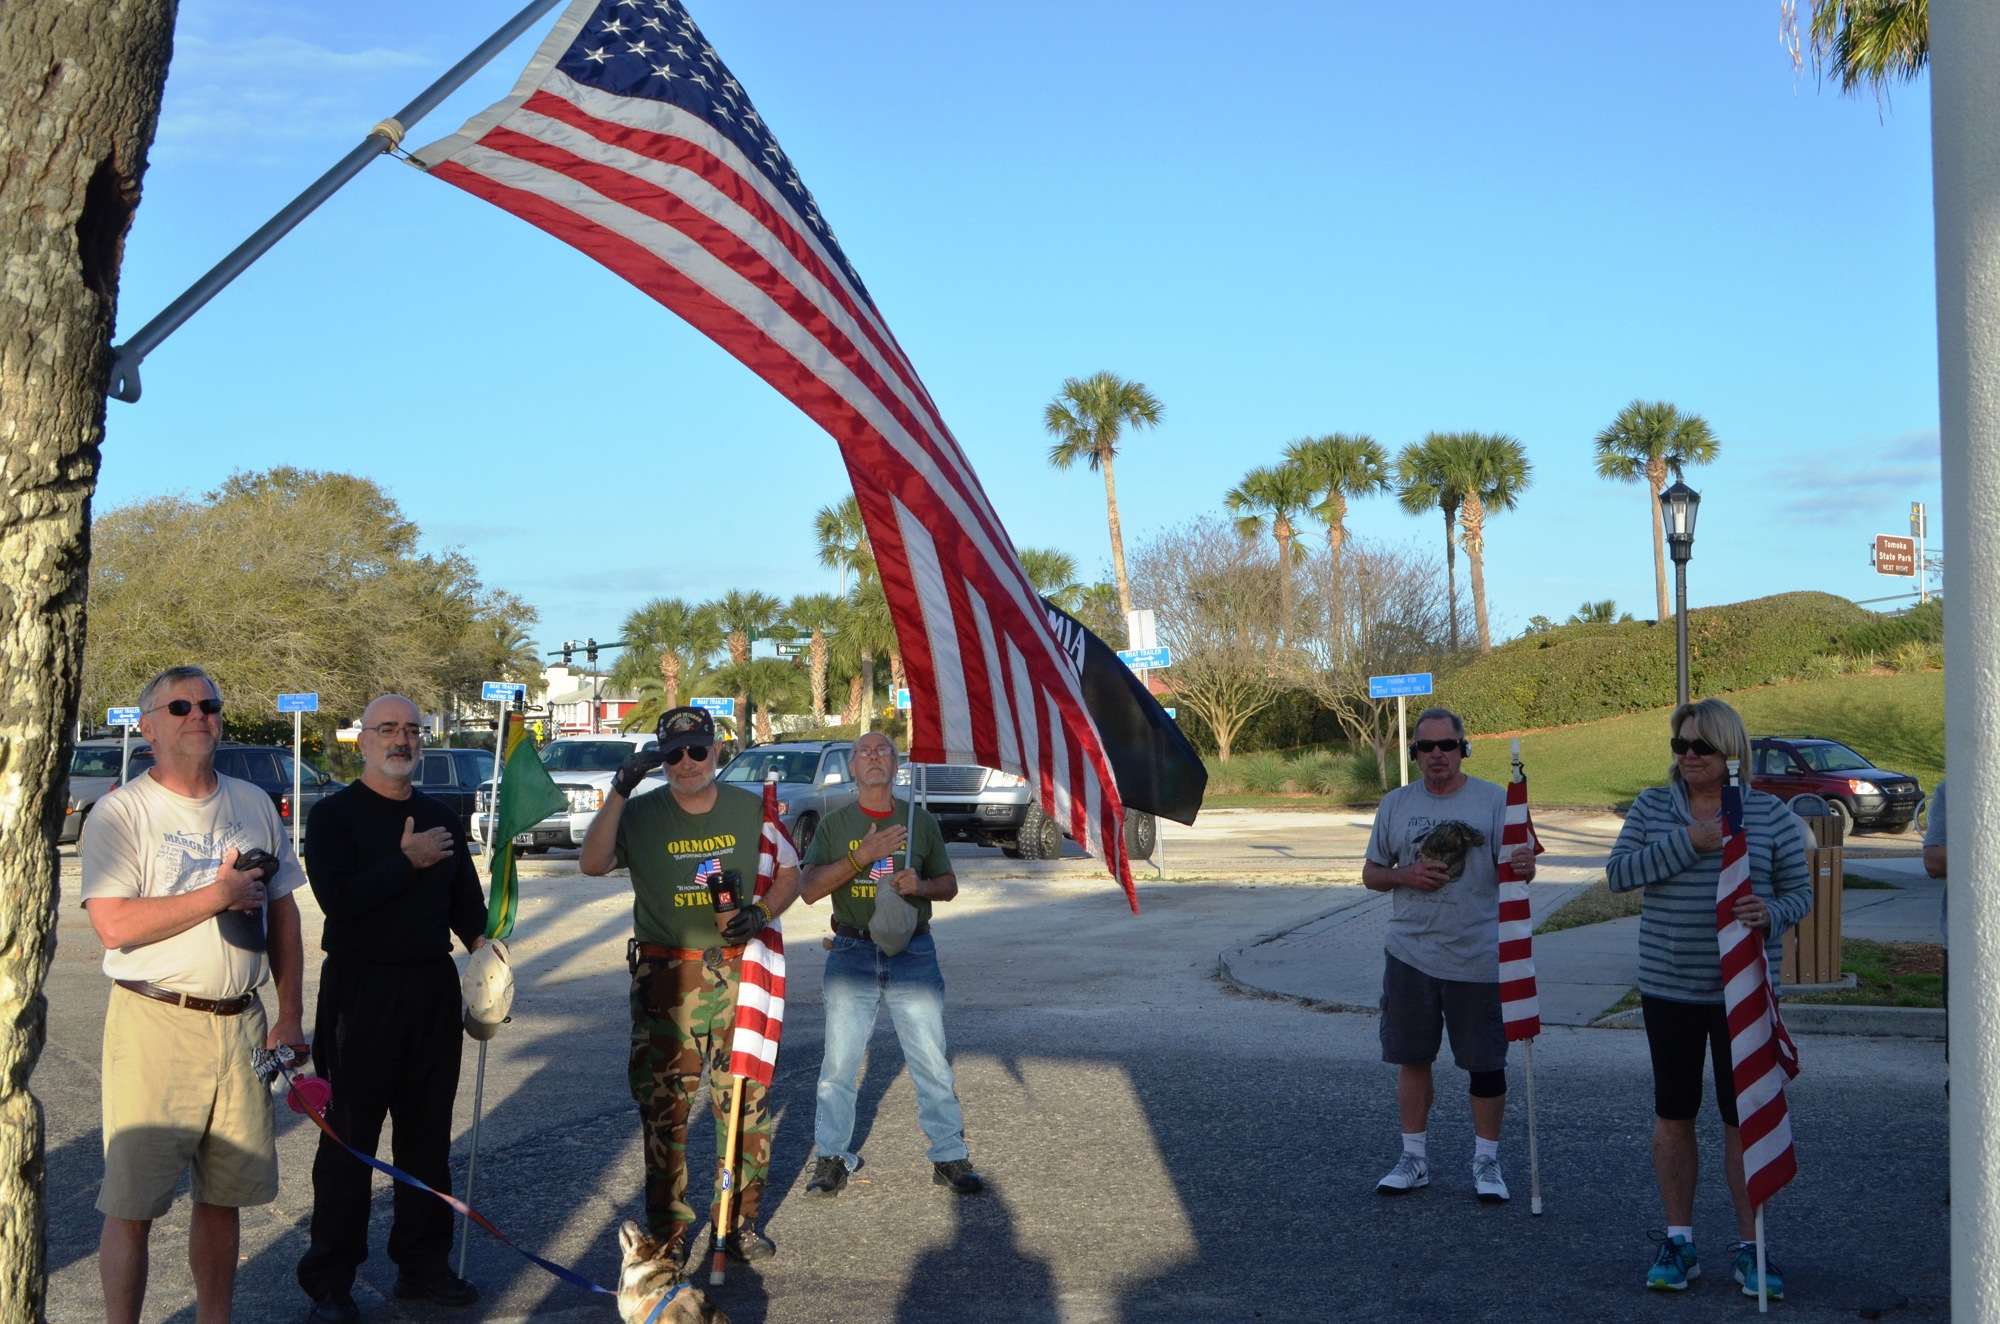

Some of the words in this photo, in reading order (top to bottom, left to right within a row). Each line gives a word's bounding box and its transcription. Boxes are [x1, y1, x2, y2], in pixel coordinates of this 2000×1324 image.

[1884, 540, 1907, 550] Tomoka
[1879, 552, 1896, 561] State
[1898, 553, 1912, 562] Park
[667, 834, 737, 854] ORMOND
[674, 892, 712, 907] STR
